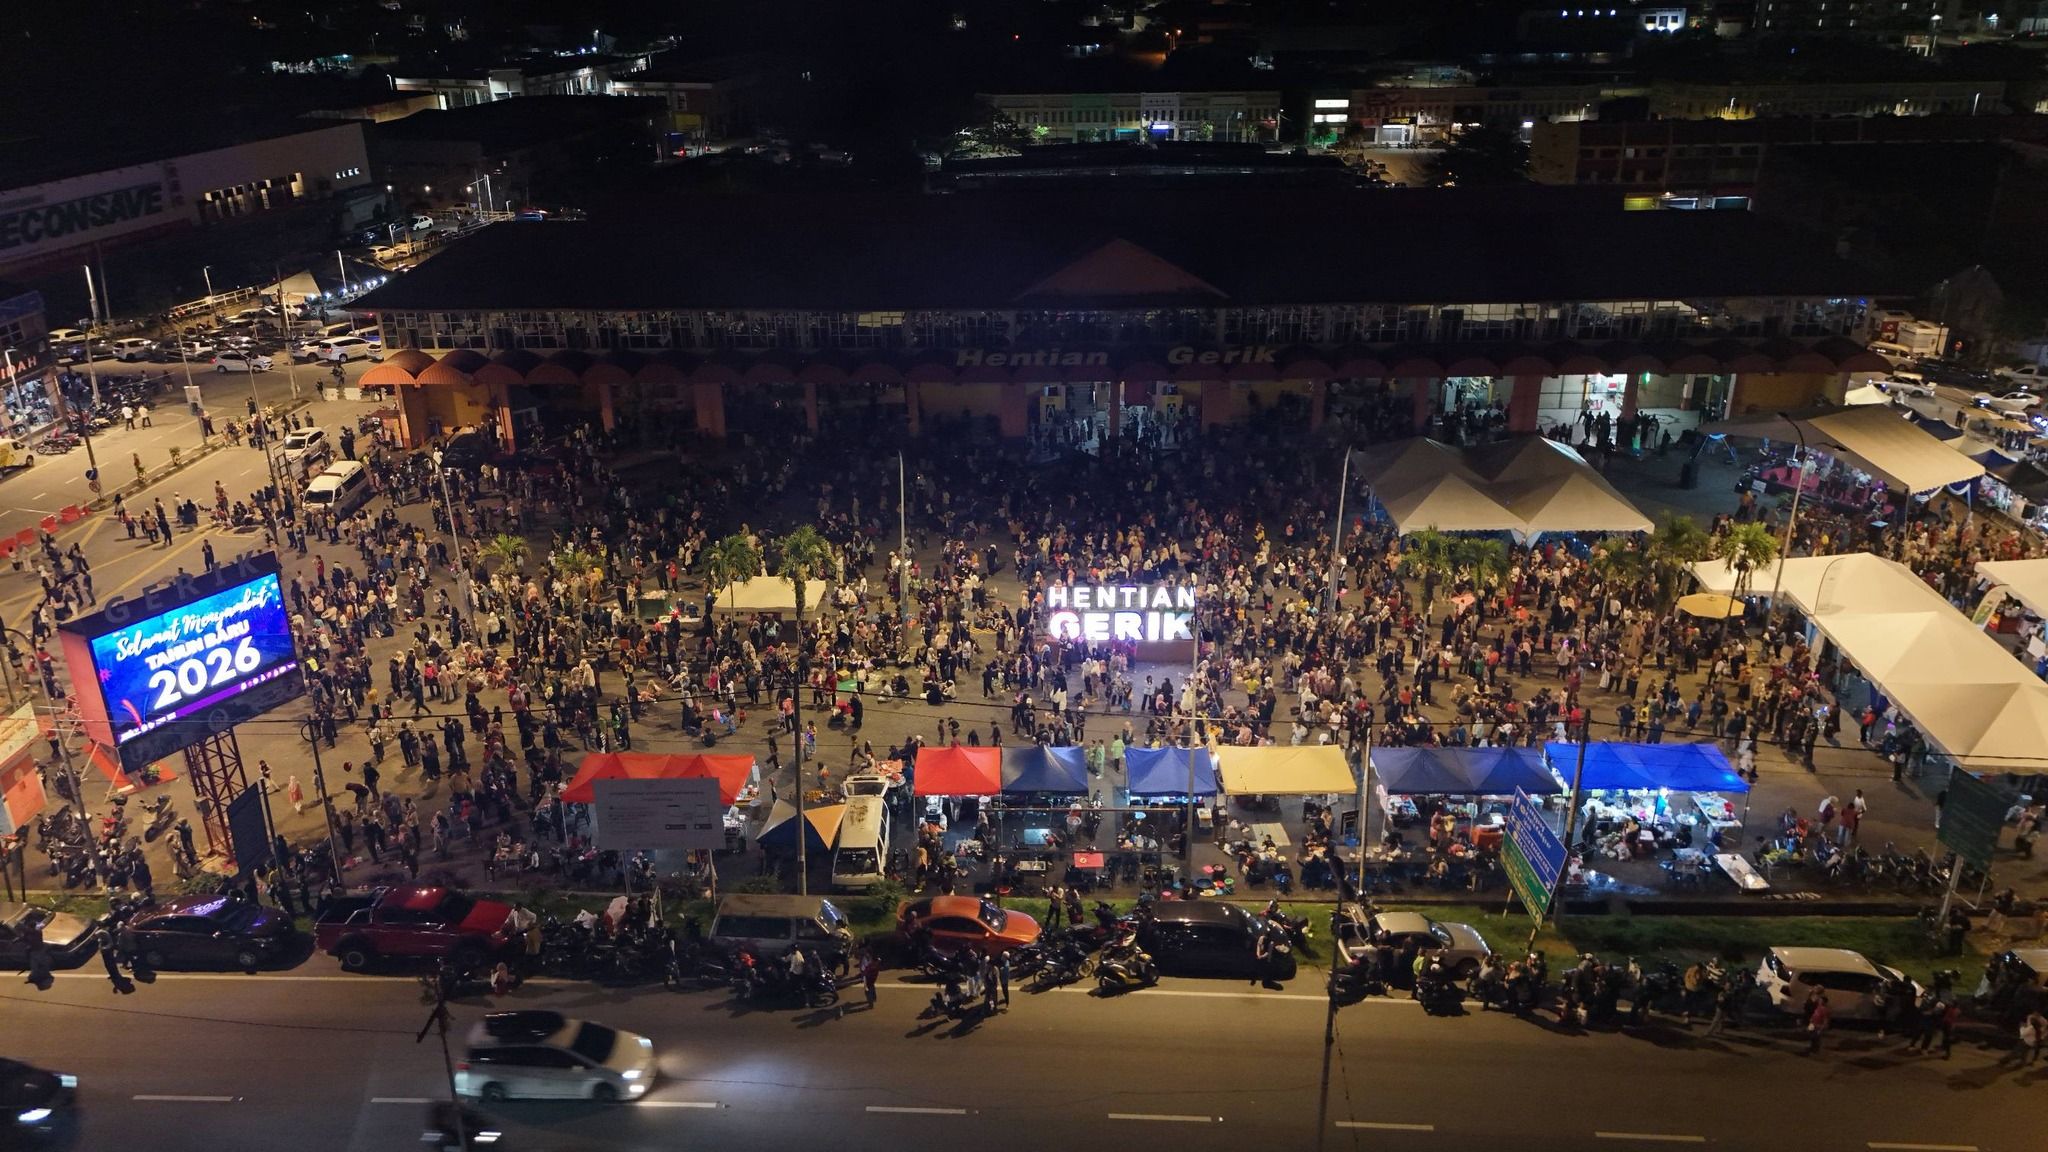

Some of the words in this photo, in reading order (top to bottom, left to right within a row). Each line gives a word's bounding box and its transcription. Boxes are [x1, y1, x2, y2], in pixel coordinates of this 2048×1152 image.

[0, 183, 163, 250] ECONSAVE
[955, 348, 1110, 367] Hentian
[1167, 345, 1277, 365] Gerik
[104, 555, 259, 624] GERIK
[1049, 586, 1195, 608] HENTIAN
[115, 617, 182, 662] Selamat
[182, 588, 270, 632] Menyambut
[144, 634, 205, 670] TAHUN
[204, 620, 250, 646] BARU
[1049, 610, 1195, 641] GERIK
[148, 636, 261, 710] 2026
